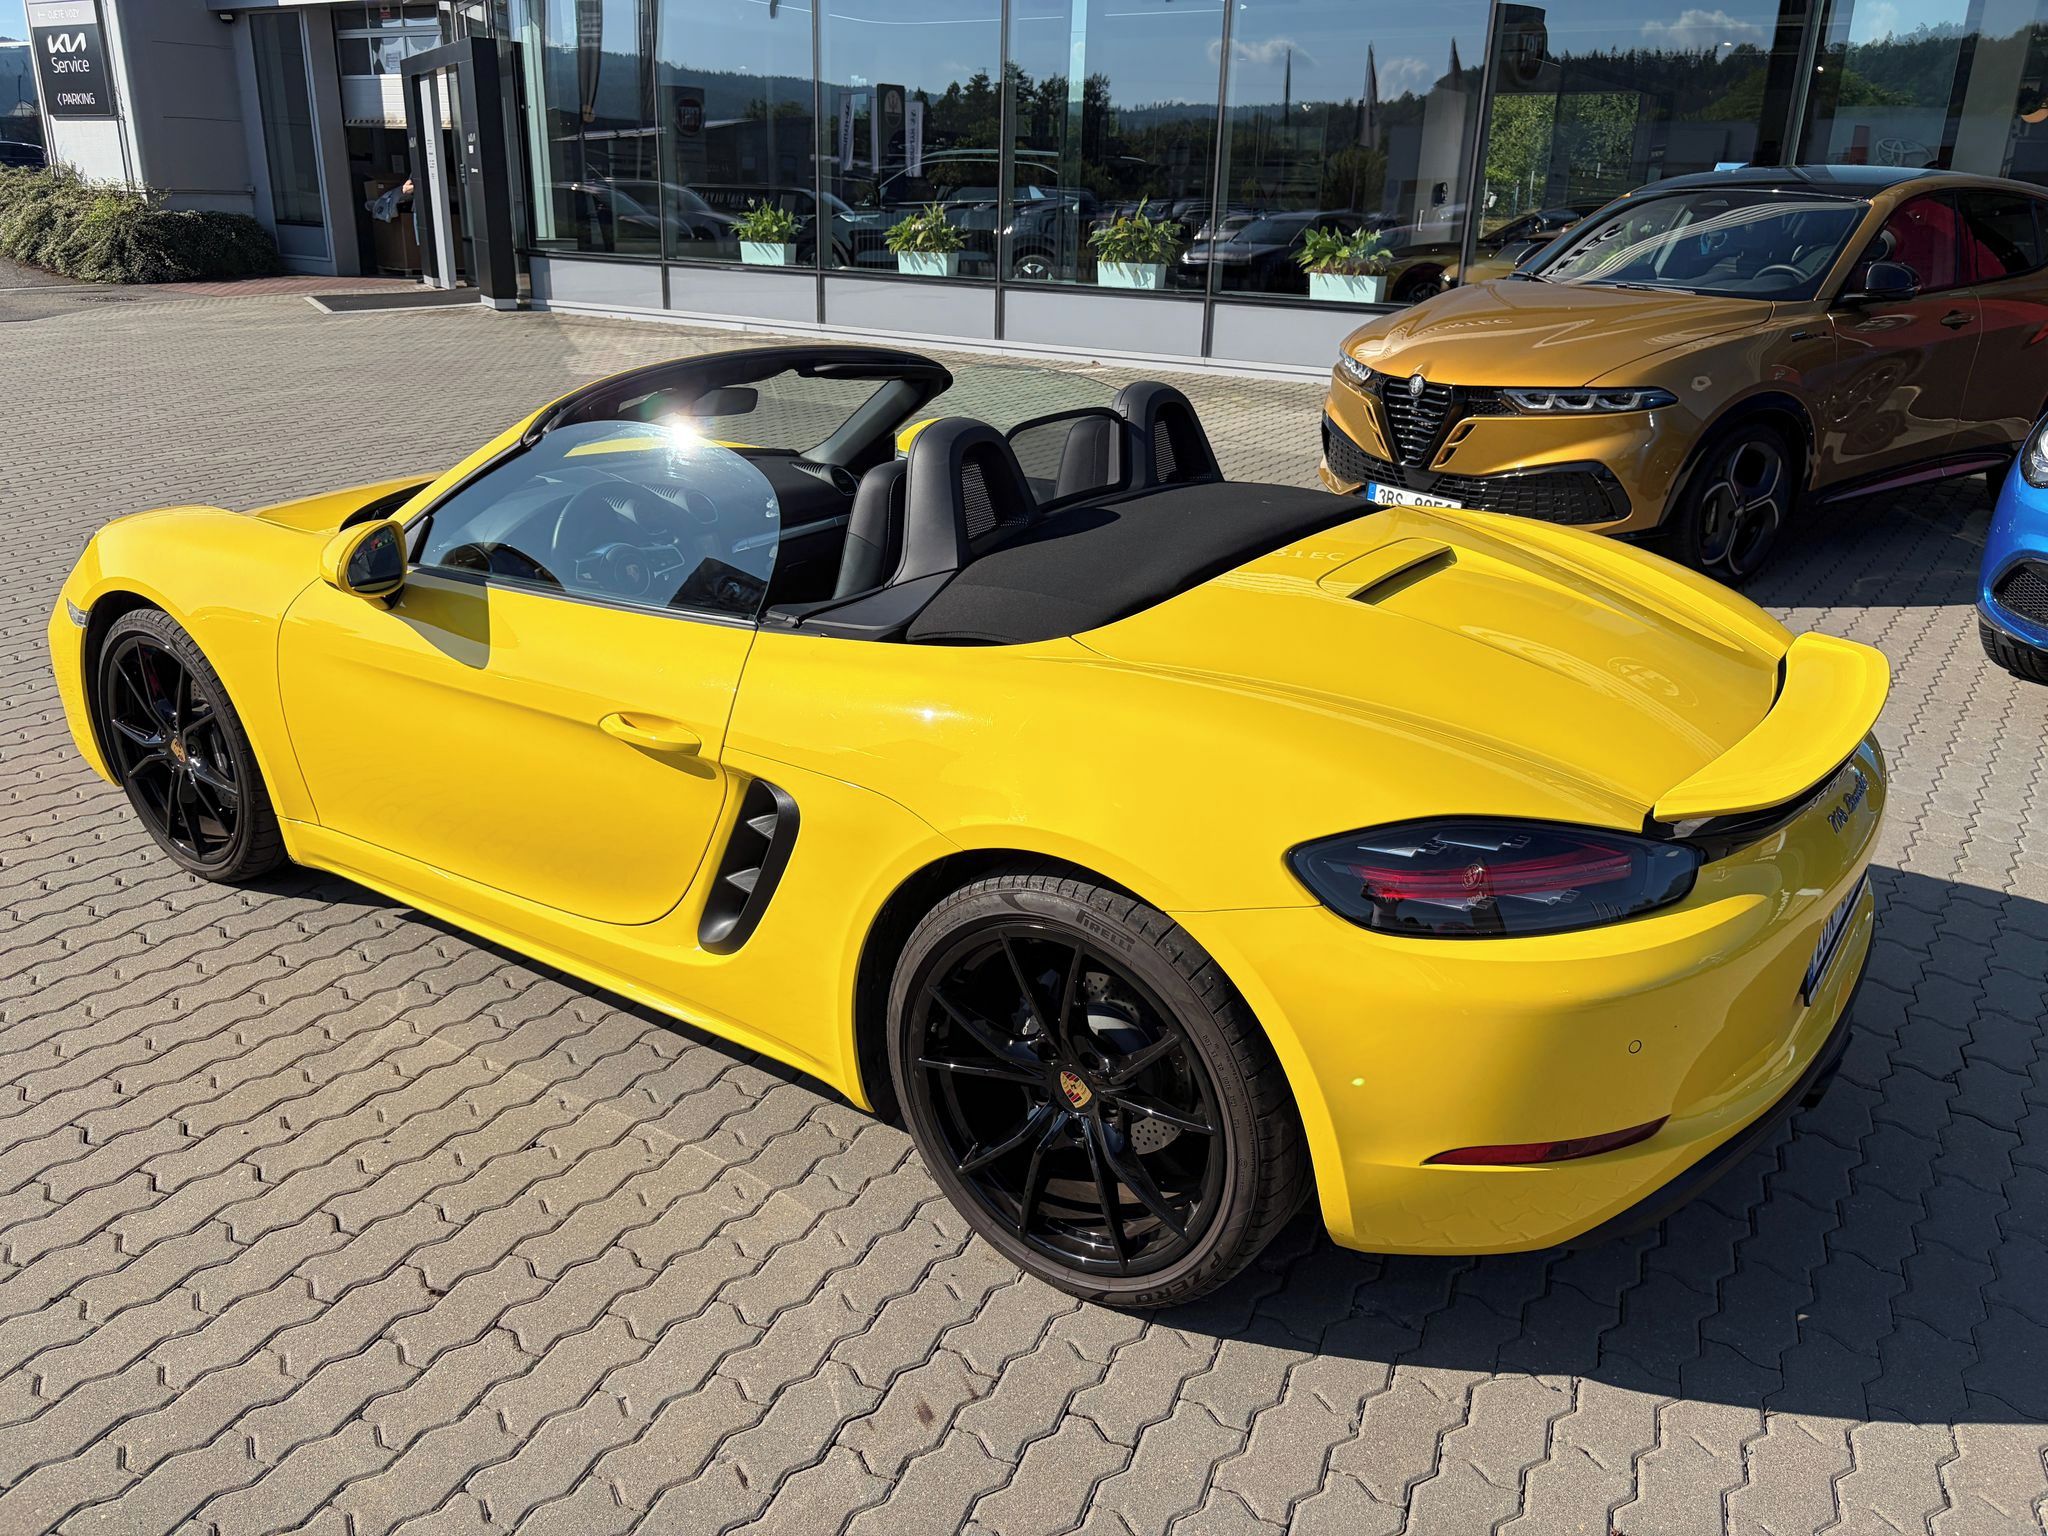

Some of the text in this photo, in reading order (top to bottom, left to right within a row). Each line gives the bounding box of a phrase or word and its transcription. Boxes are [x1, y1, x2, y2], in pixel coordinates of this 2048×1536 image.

[47, 32, 87, 53] KIA
[51, 56, 90, 73] Service
[62, 92, 96, 105] PARKING
[1076, 909, 1136, 953] PIRELLI
[1135, 1268, 1204, 1304] ZERO
